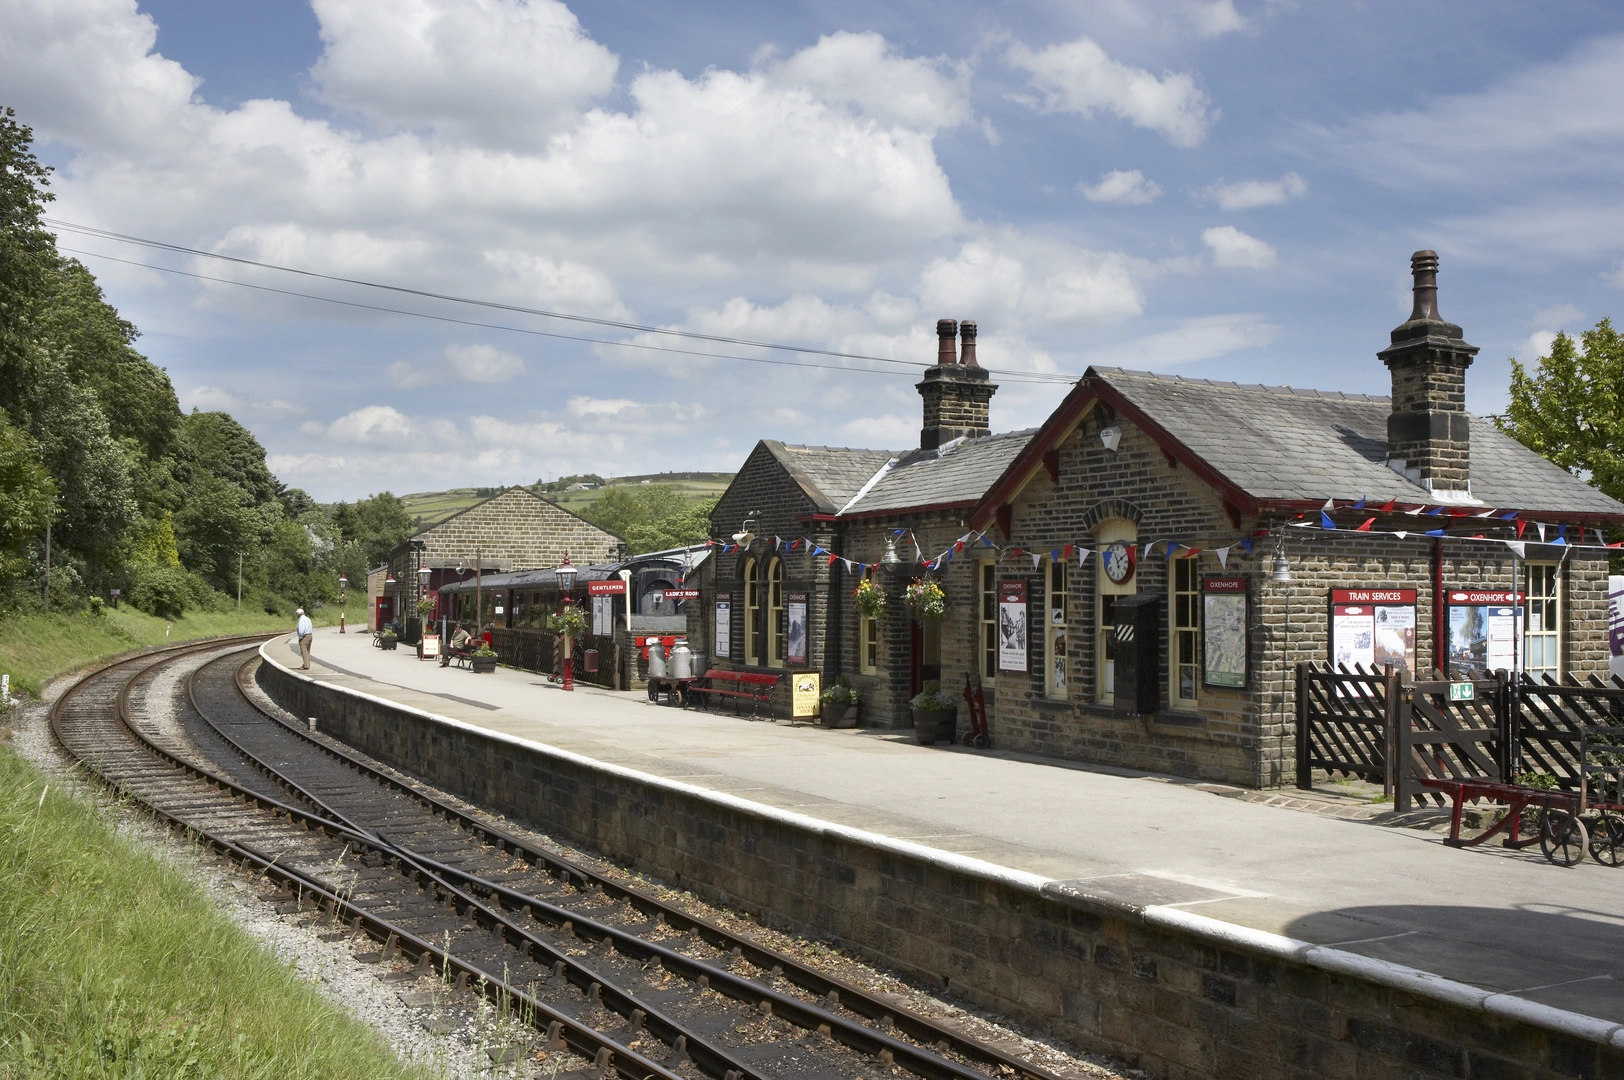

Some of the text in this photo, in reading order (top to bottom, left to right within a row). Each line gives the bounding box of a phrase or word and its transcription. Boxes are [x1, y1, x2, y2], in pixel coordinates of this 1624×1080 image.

[1349, 592, 1401, 601] TRAIN SERVICES
[1470, 593, 1504, 602] OXENHOPE
